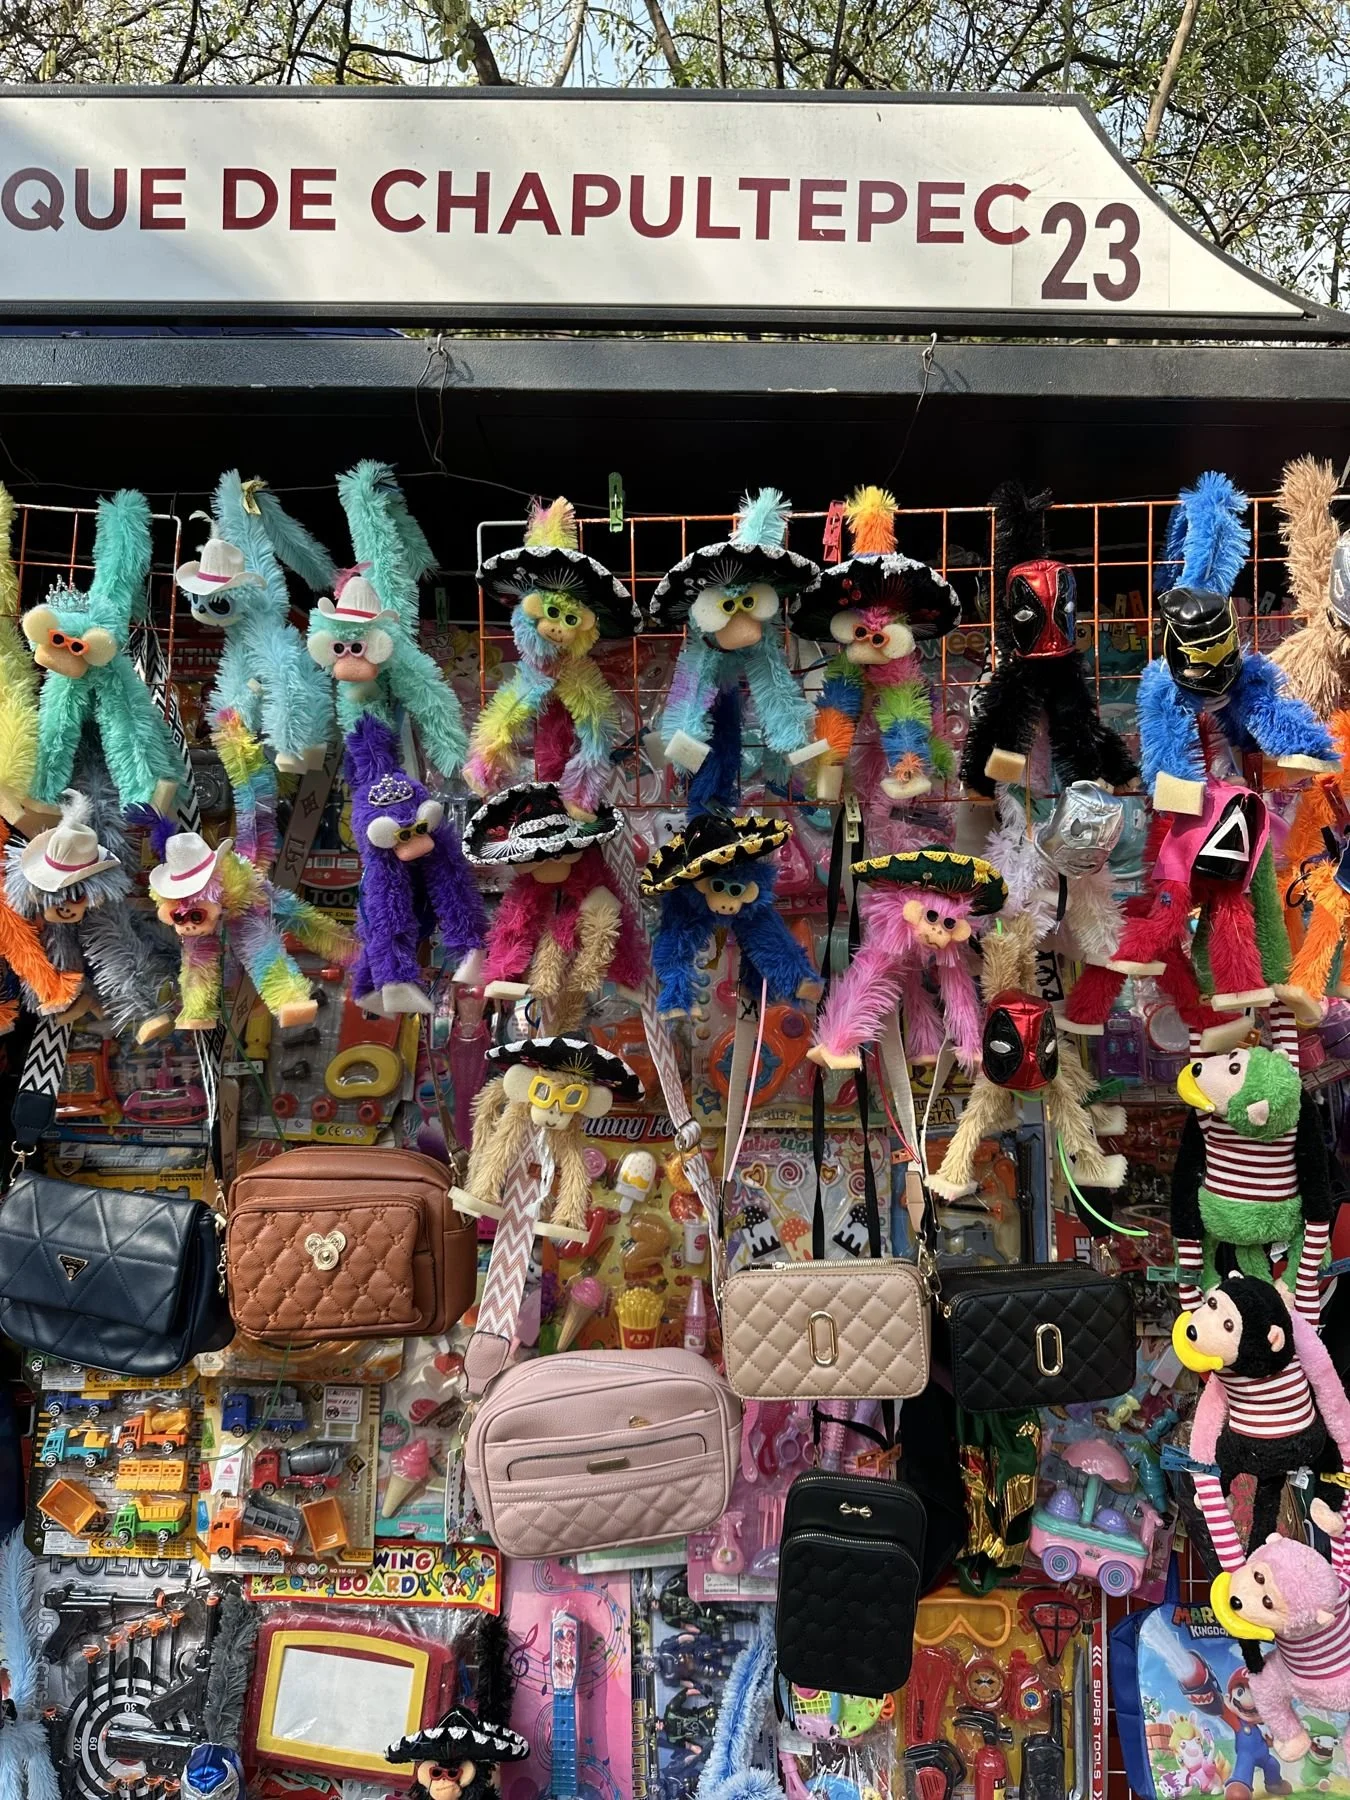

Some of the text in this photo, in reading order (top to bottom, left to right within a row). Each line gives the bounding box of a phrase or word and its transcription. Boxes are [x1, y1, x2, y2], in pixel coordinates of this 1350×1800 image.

[1, 168, 1032, 246] QUE DE CHAPULTEPEC
[1042, 202, 1140, 301] 23
[328, 1126, 341, 1136] CE
[584, 1116, 647, 1141] unny
[49, 1557, 192, 1578] POLICE
[339, 1575, 417, 1595] BOARD
[124, 1702, 137, 1713] 30
[1092, 1679, 1102, 1779] SUPER TOOLS
[88, 1736, 97, 1750] 60
